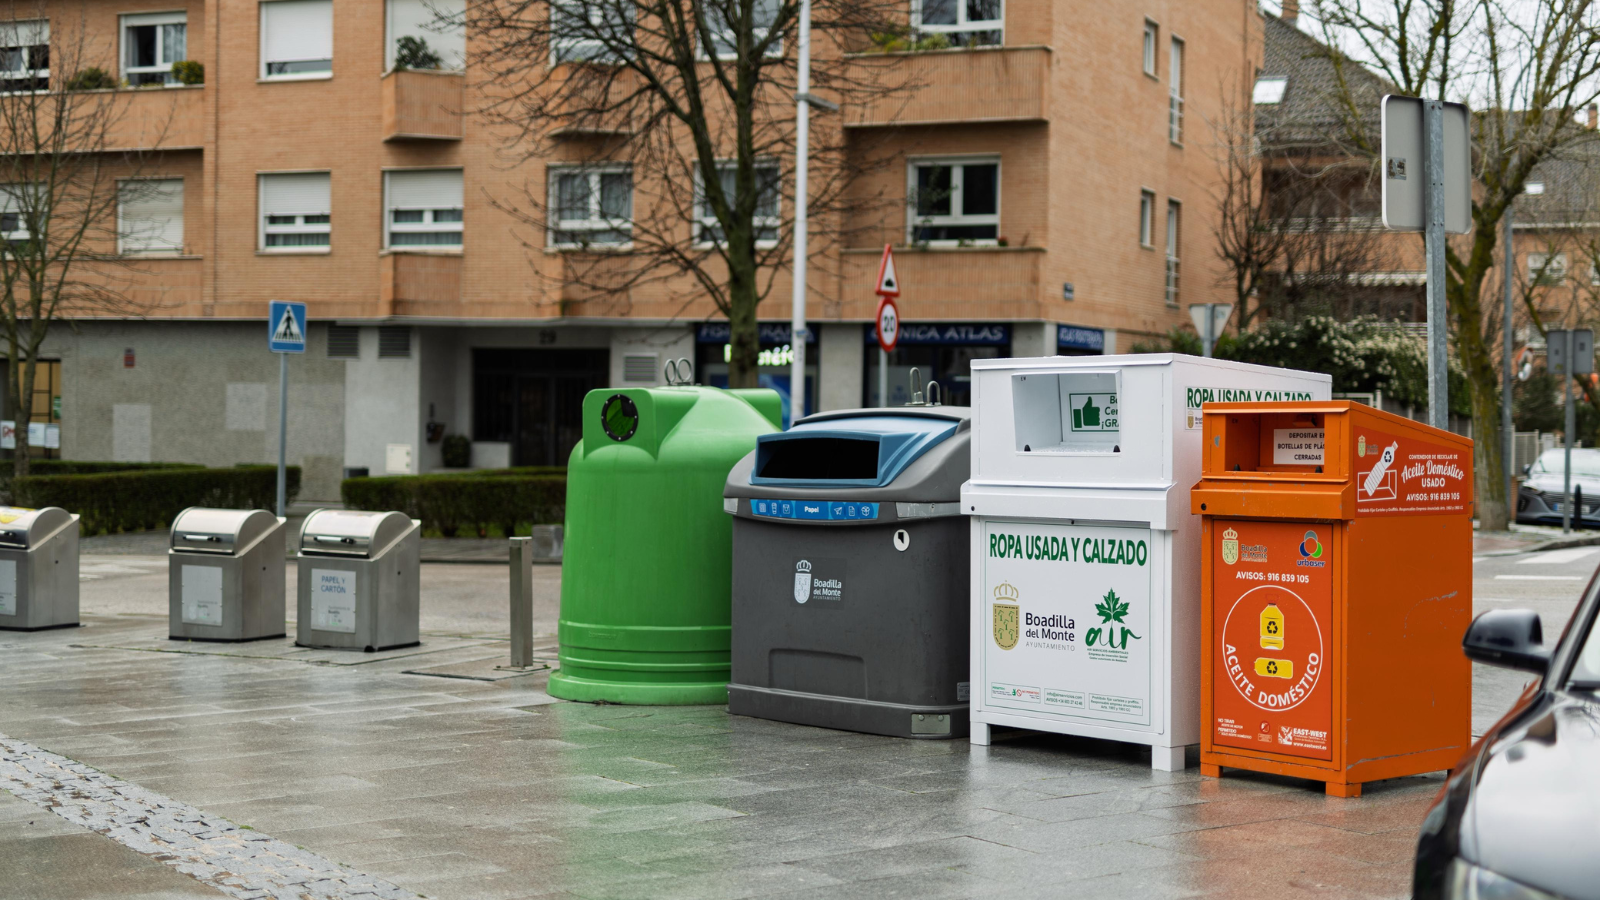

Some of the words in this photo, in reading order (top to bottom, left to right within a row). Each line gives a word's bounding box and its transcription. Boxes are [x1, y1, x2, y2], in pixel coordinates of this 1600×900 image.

[883, 315, 895, 332] 20
[944, 325, 1004, 341] ATLAS
[1187, 387, 1215, 408] ROPA
[1401, 462, 1425, 483] Aceite
[1426, 460, 1464, 480] Doméstico
[1421, 478, 1446, 488] USADO
[1406, 493, 1429, 501] AVISOS:
[1430, 493, 1439, 501] 916
[1451, 492, 1460, 500] 105
[804, 505, 819, 513] Papel
[989, 533, 1023, 559] ROPA
[1026, 535, 1069, 562] USADA
[1071, 537, 1081, 562] Y
[1082, 537, 1148, 566] CALZADO
[1241, 544, 1268, 552] Boadilla
[1296, 558, 1326, 568] urbaser
[321, 575, 340, 584] PAPEL
[341, 576, 346, 584] Y
[1236, 571, 1266, 580] AVISOS:
[1267, 573, 1280, 581] 916
[1281, 574, 1295, 582] 839
[1297, 575, 1310, 583] 105
[320, 584, 346, 594] CARTÓN
[813, 578, 842, 589] Boadilla
[813, 588, 822, 596] del
[822, 588, 842, 597] Monte
[1025, 612, 1075, 629] Boadilla
[1025, 628, 1039, 639] del
[1041, 629, 1075, 641] Monte
[1085, 626, 1142, 650] air
[1025, 641, 1075, 651] AYUNTAMIENTO
[1226, 644, 1255, 696] ACEITE
[1258, 652, 1320, 707] DOMÉSTICO
[1293, 727, 1327, 738] EAST-WEST
